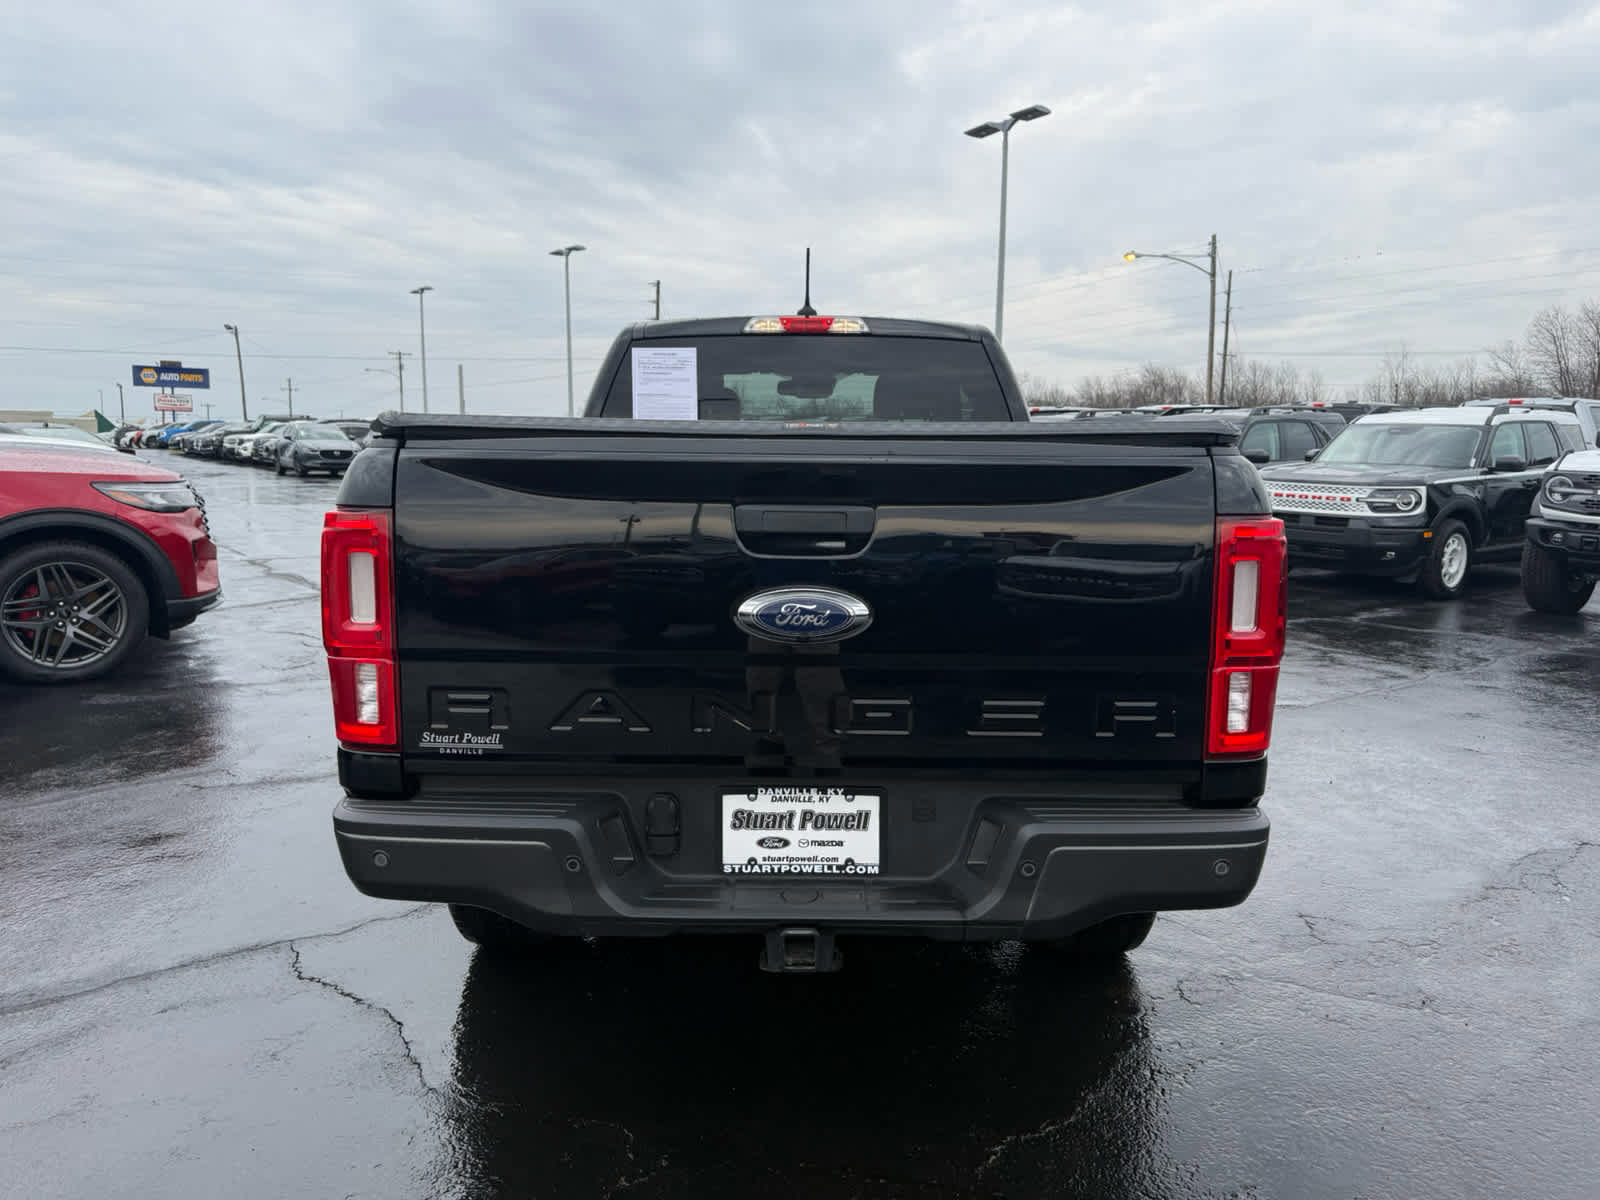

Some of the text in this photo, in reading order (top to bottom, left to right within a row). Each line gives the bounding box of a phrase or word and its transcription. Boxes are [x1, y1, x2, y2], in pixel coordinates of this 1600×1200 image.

[160, 372, 204, 383] AUTO PARTS
[1273, 492, 1352, 502] BRONCO
[775, 603, 831, 627] Ford
[427, 687, 1177, 738] RANGER
[422, 731, 500, 744] Stuart Powell
[439, 747, 483, 755] DANVILLE
[757, 787, 844, 796] DANVILLE, KY
[770, 795, 816, 804] DANVILLE,
[730, 808, 872, 831] Stuart Powell
[762, 838, 784, 848] Ford
[762, 855, 839, 863] stuartpowell.com
[723, 864, 879, 874] STUARTPOWELL.COM
